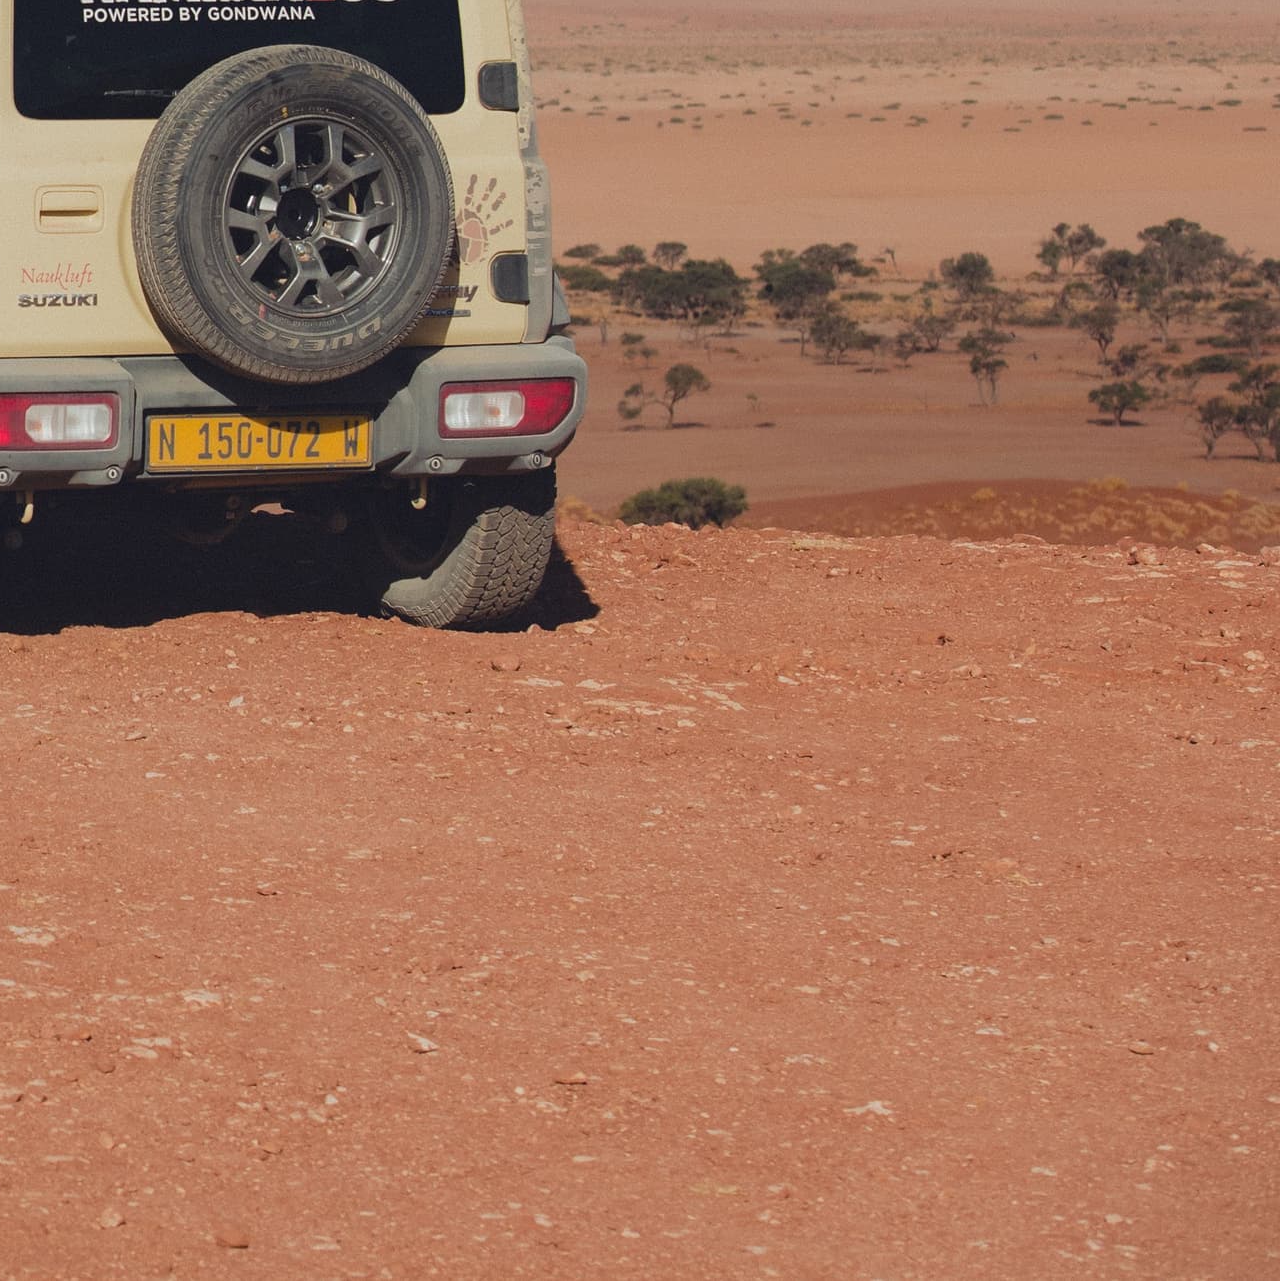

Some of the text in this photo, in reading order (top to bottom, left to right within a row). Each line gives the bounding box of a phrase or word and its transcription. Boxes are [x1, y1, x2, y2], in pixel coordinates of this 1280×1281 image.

[83, 6, 316, 23] POWERED BY GONDWANA
[21, 262, 93, 290] Naukluft
[17, 293, 98, 307] SUZUKI
[158, 420, 358, 460] N 150-072 W
